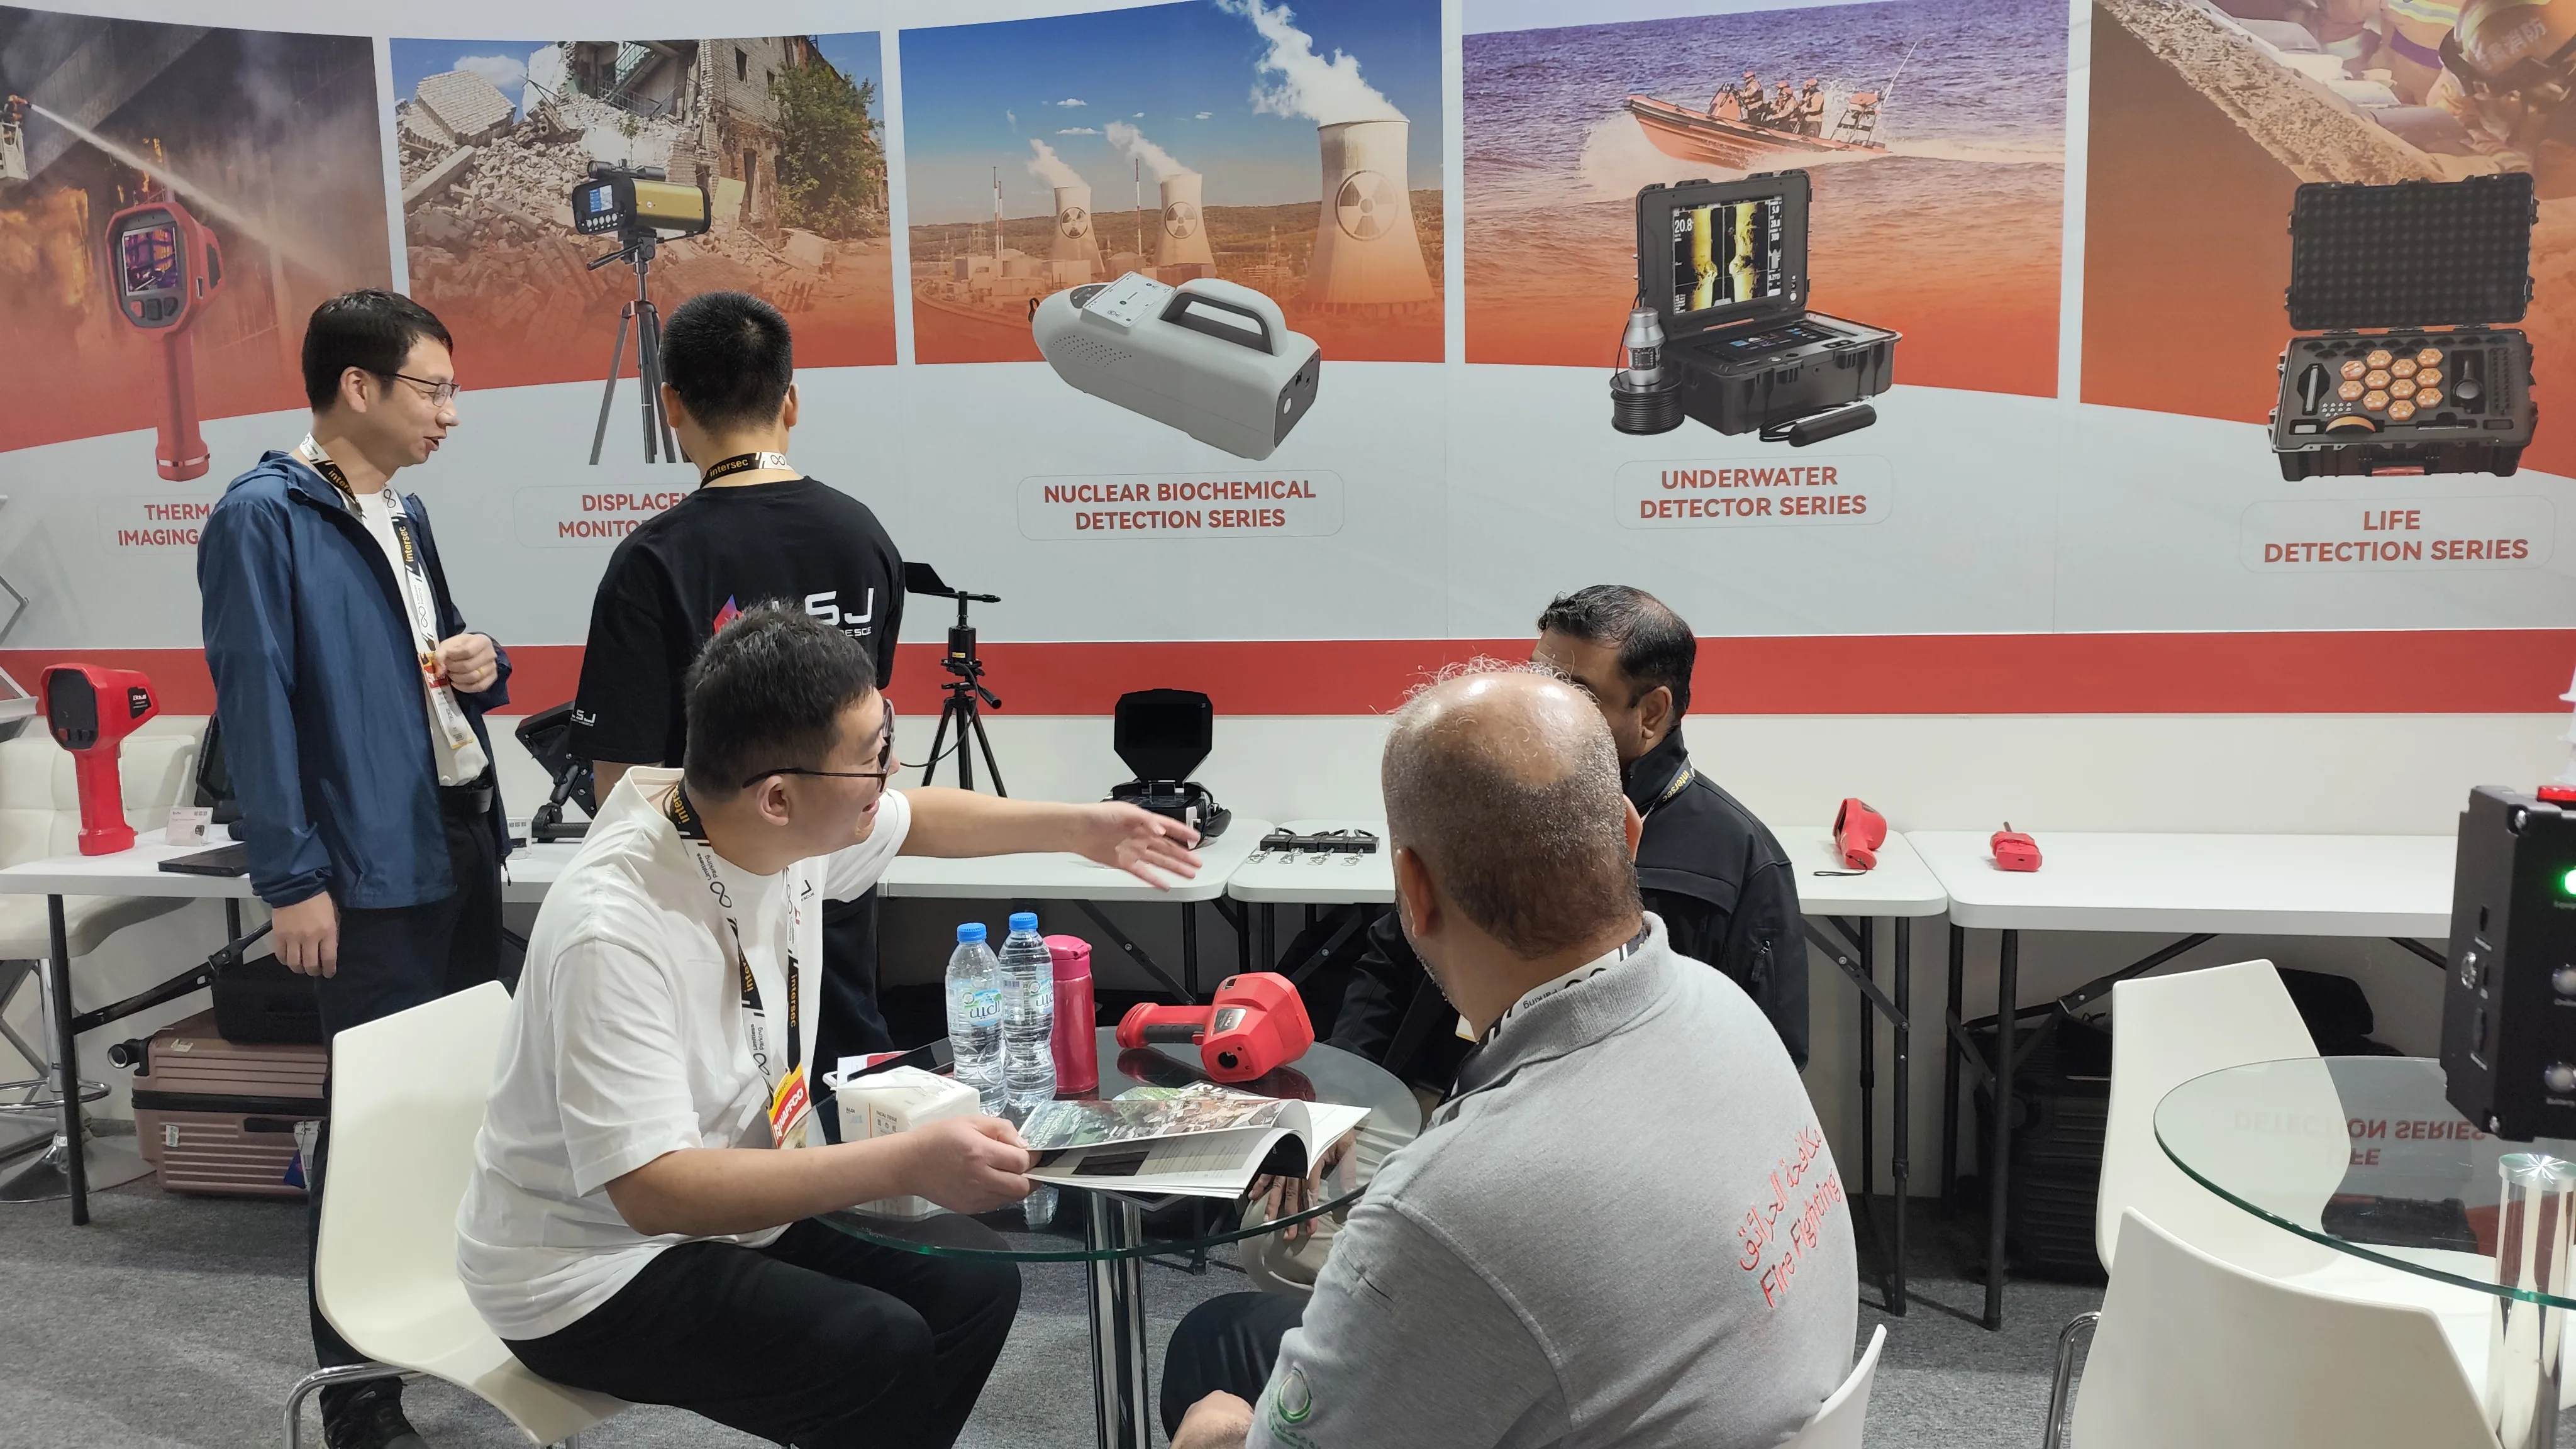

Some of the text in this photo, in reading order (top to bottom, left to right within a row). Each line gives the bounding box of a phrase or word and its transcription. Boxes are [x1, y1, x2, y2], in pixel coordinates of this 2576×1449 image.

[709, 458, 748, 477] intersec
[1662, 465, 1838, 489] UNDERWATER
[1044, 480, 1316, 503] NUCLEAR BIOCHEMICAL
[144, 503, 214, 520] THERM
[1076, 508, 1285, 530] DETECTION SERIES
[1640, 494, 1867, 519] DETECTOR SERIES
[558, 520, 646, 538] MONITO
[2363, 509, 2421, 531] LIFE
[118, 528, 199, 546] IMAGING
[399, 526, 414, 562] intersec
[2264, 538, 2529, 563] DETECTION SERIES
[772, 587, 875, 626] SJ
[1662, 770, 1692, 802] intersec
[696, 853, 712, 881] Limitless
[704, 854, 718, 879] Parking
[969, 1000, 1001, 1019] العين
[750, 1023, 758, 1051] Limitless
[777, 1087, 804, 1130] NAFFCO
[1740, 1126, 1822, 1271] مكافحة الحرائق
[1760, 1168, 1842, 1309] Fire Fighting
